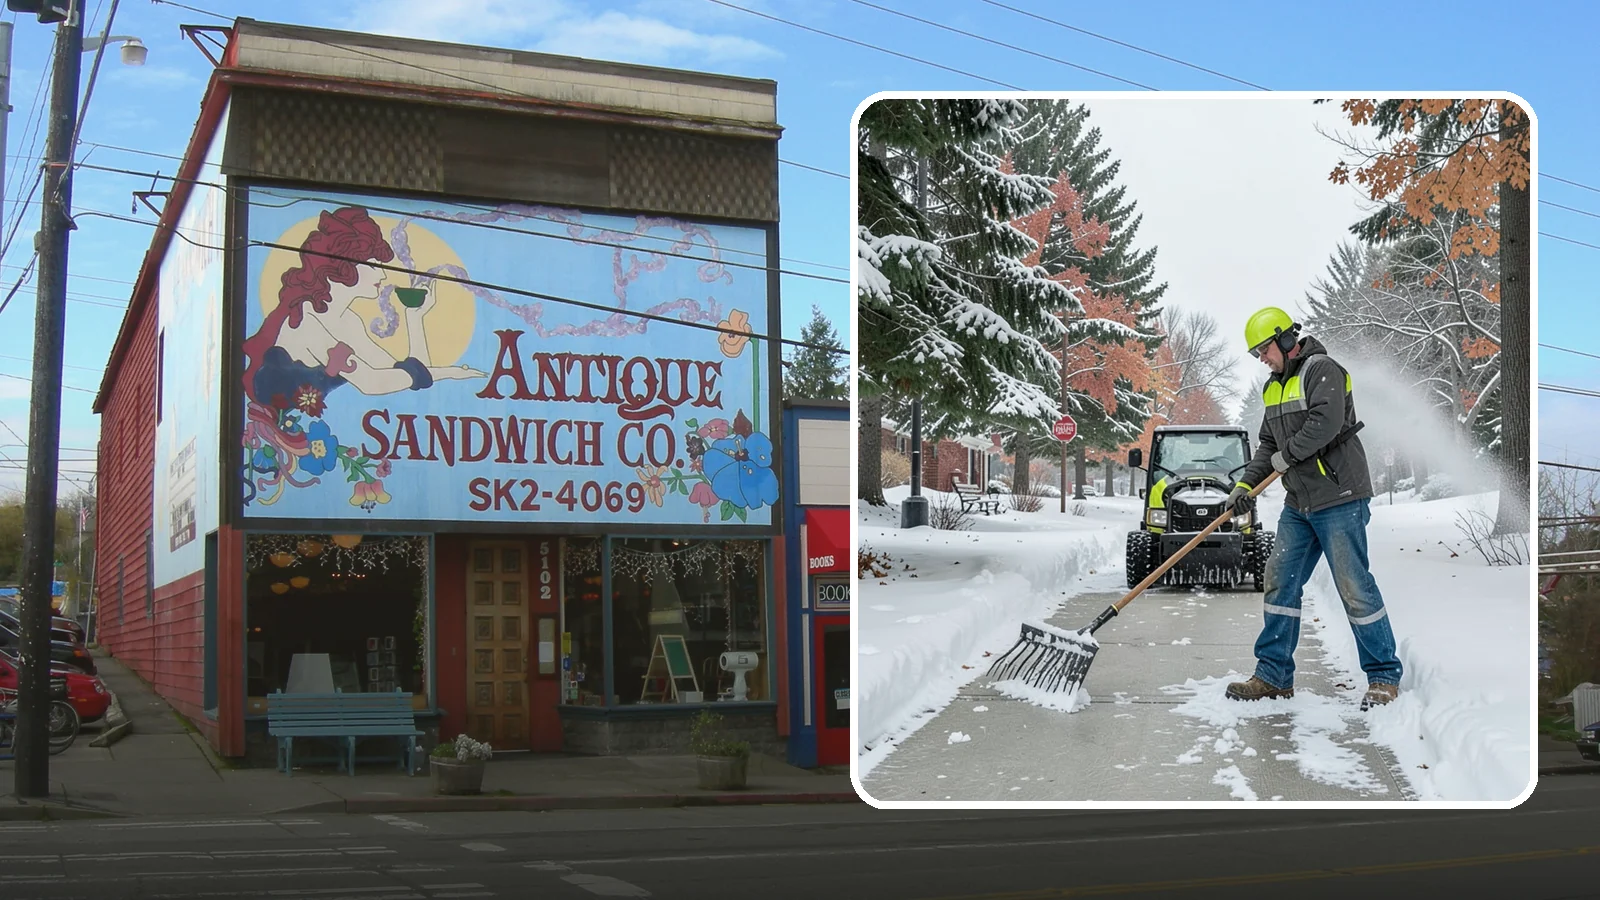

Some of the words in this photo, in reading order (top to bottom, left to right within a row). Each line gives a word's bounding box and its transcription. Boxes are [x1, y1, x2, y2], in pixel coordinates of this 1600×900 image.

[476, 329, 724, 420] ANTIQUE
[361, 408, 604, 467] SANDWICH
[616, 422, 685, 468] CO.
[469, 477, 645, 513] SK2-4069
[540, 541, 551, 600] 5102
[809, 555, 835, 569] BOOKS
